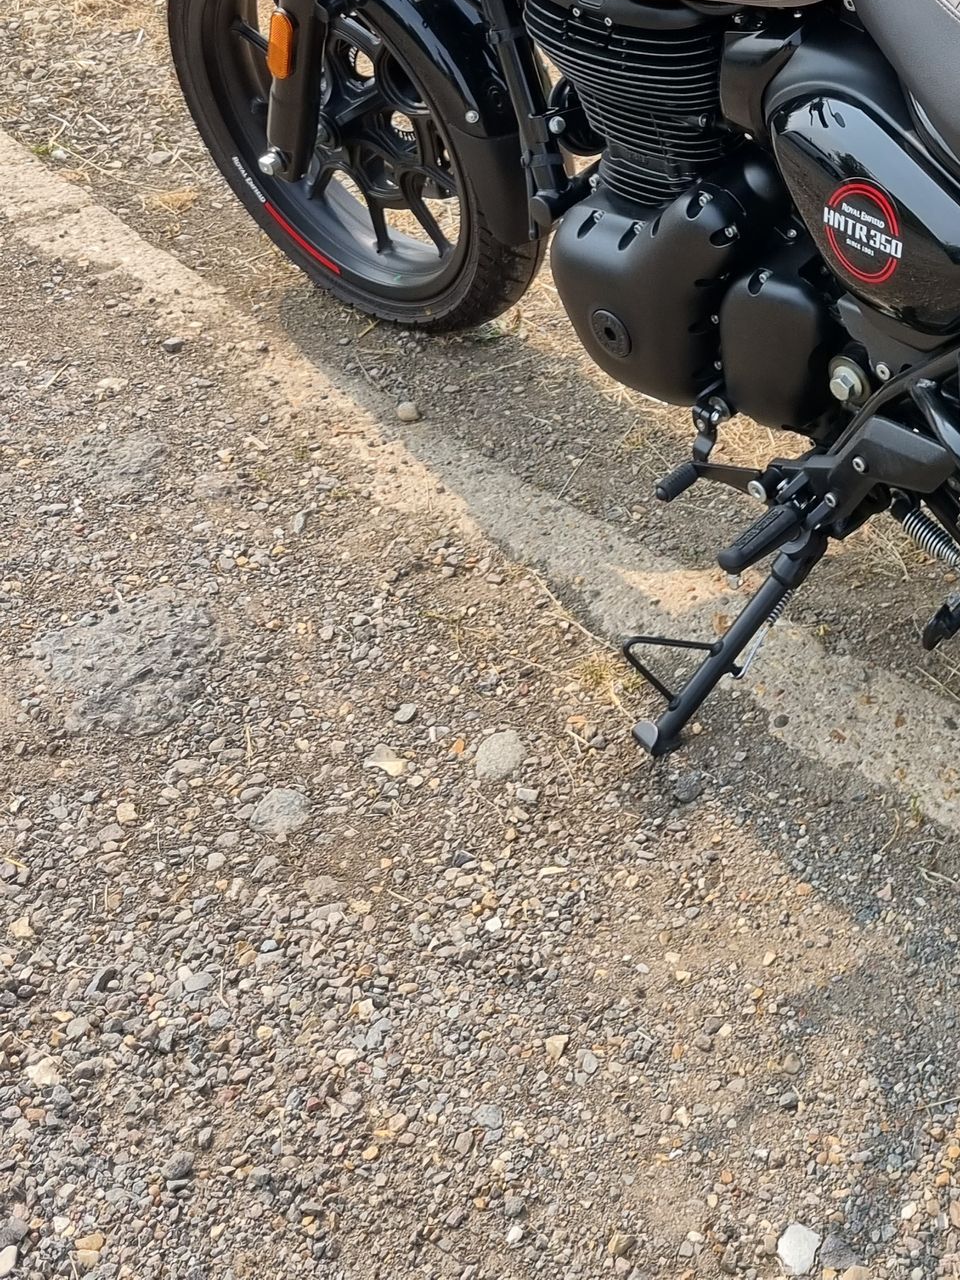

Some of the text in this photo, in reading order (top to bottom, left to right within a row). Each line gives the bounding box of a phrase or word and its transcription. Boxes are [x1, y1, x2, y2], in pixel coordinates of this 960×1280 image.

[232, 156, 248, 178] ROYAL
[841, 202, 885, 229] ROYAL ENFIELD
